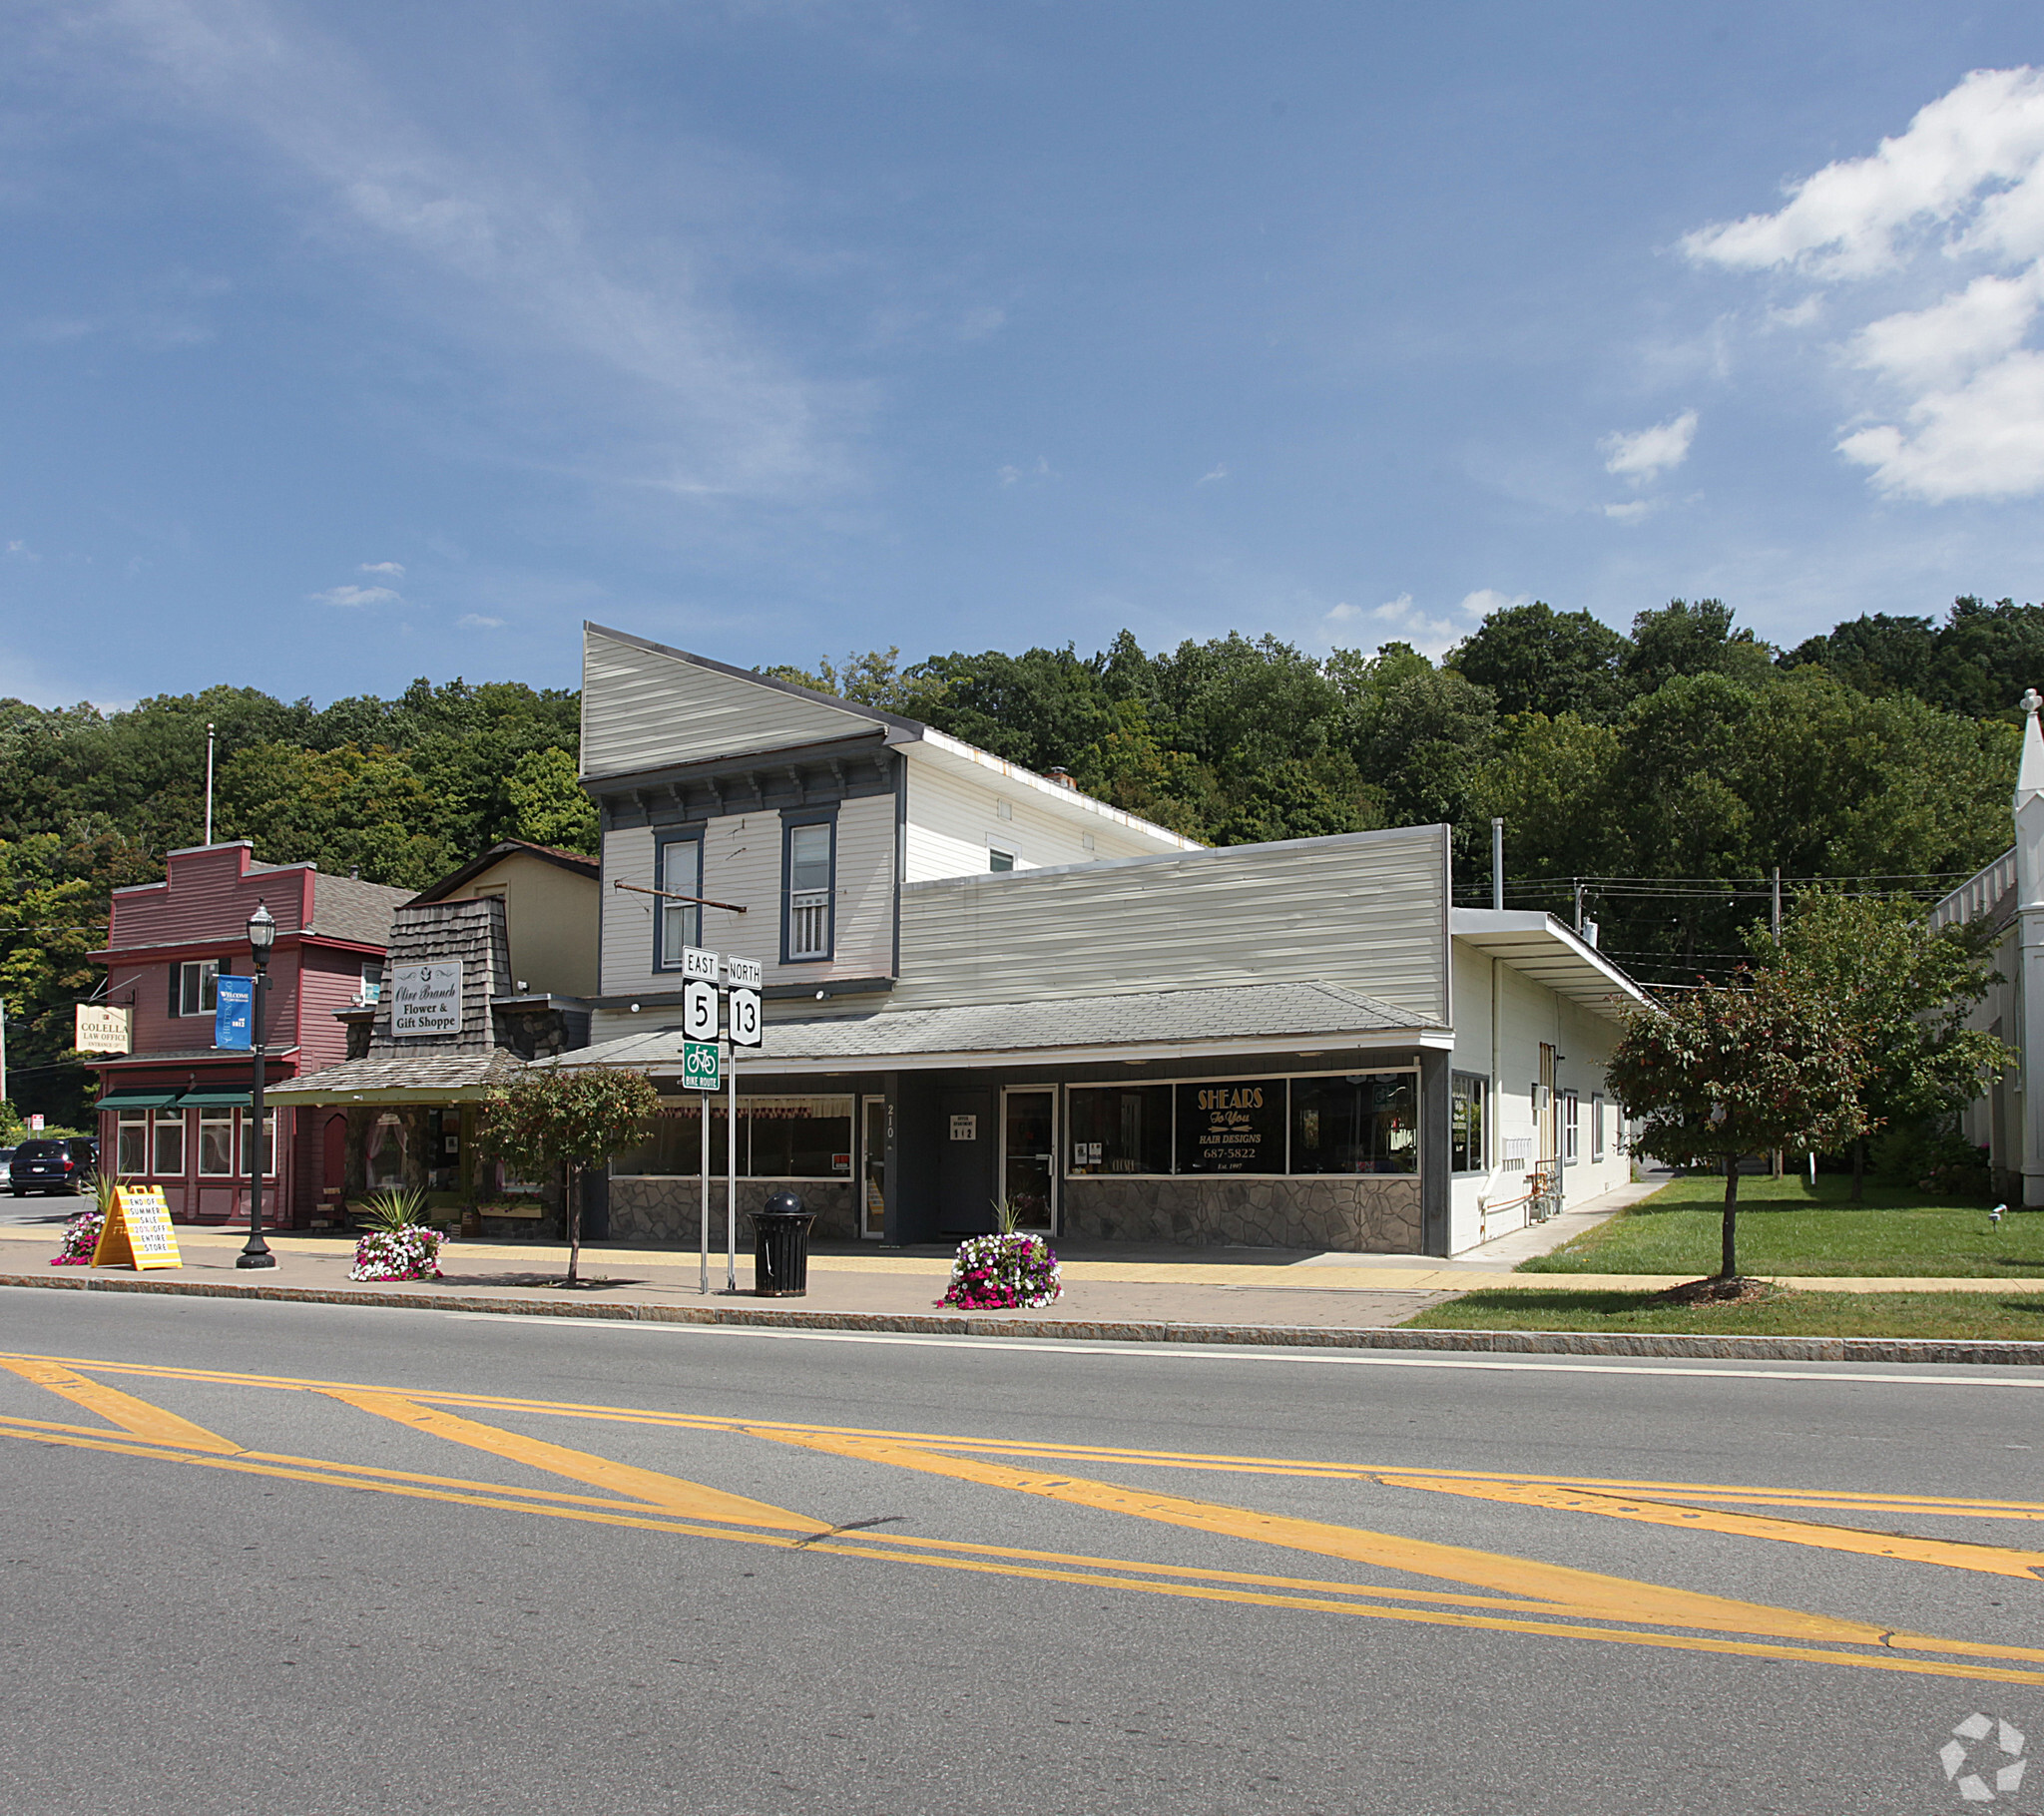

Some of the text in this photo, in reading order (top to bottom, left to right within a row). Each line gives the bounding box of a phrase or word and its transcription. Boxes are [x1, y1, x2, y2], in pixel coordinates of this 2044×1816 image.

[688, 955, 715, 975] EAST
[730, 963, 761, 983] NORTH
[395, 986, 417, 1002] Olive
[419, 983, 456, 1000] Branch
[404, 1003, 447, 1015] Flower &
[696, 995, 708, 1027] 5
[396, 1017, 455, 1030] Gift Shoppe
[736, 1001, 756, 1033] 13
[81, 1023, 129, 1034] COLELLA
[686, 1076, 717, 1088] BIKE ROUTE
[1198, 1088, 1264, 1110] SHEARS
[1210, 1111, 1251, 1126] To You
[1199, 1134, 1262, 1144] HAIR DESIGNS
[1204, 1148, 1257, 1158] 687-5822
[141, 1234, 166, 1243] ENTIRE
[144, 1243, 167, 1252] STORE
